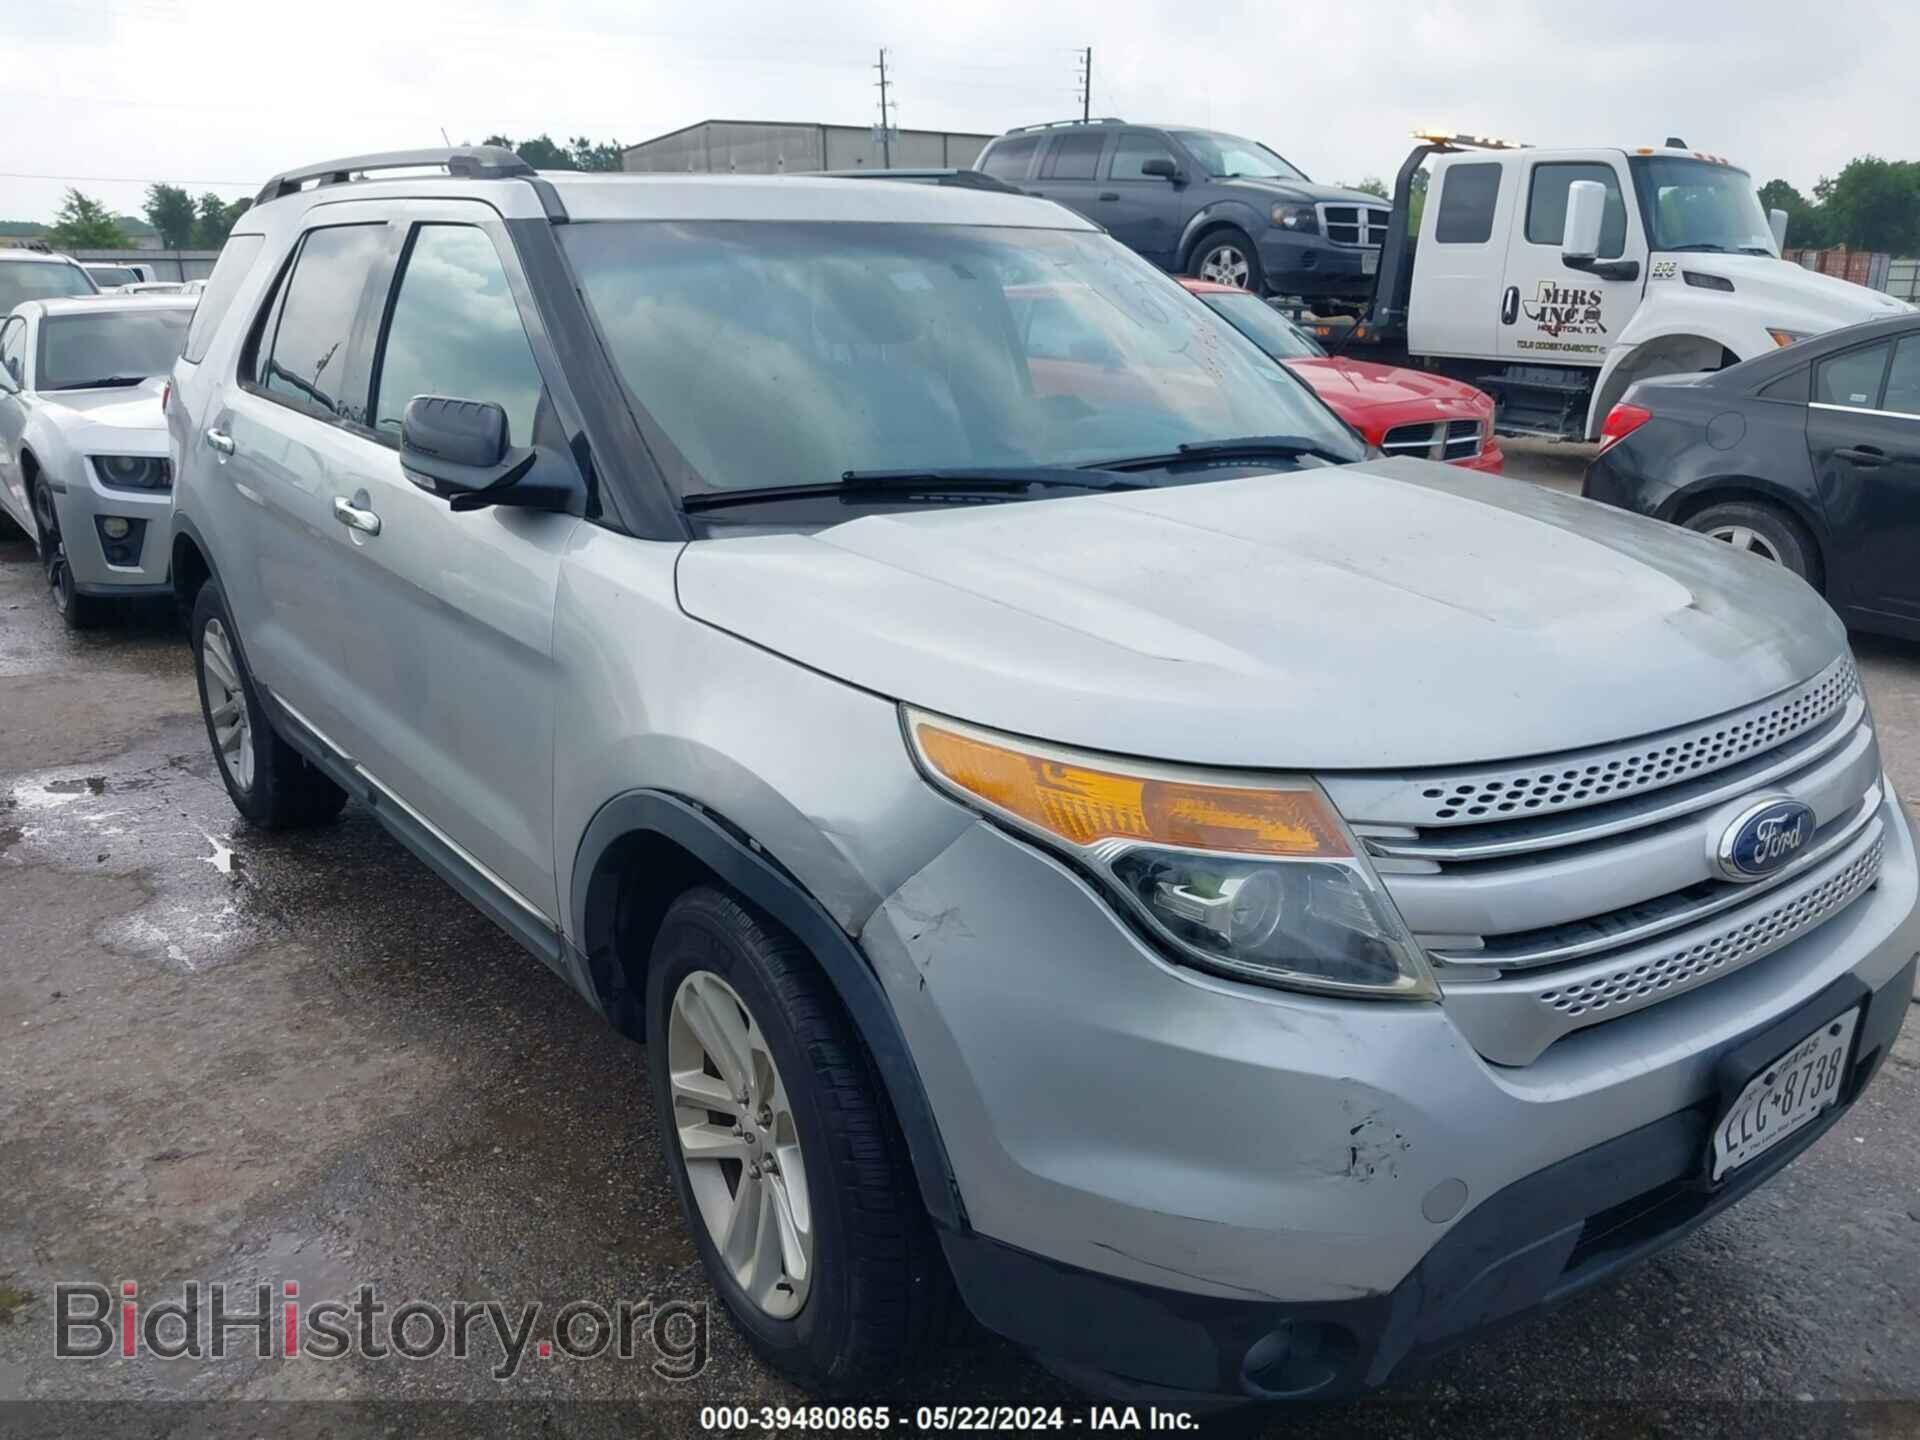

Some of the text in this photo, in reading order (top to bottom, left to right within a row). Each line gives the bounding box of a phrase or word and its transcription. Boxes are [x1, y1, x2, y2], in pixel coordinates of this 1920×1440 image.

[1654, 262, 1677, 272] 202
[1585, 326, 1598, 334] TX
[1754, 813, 1801, 864] Ford
